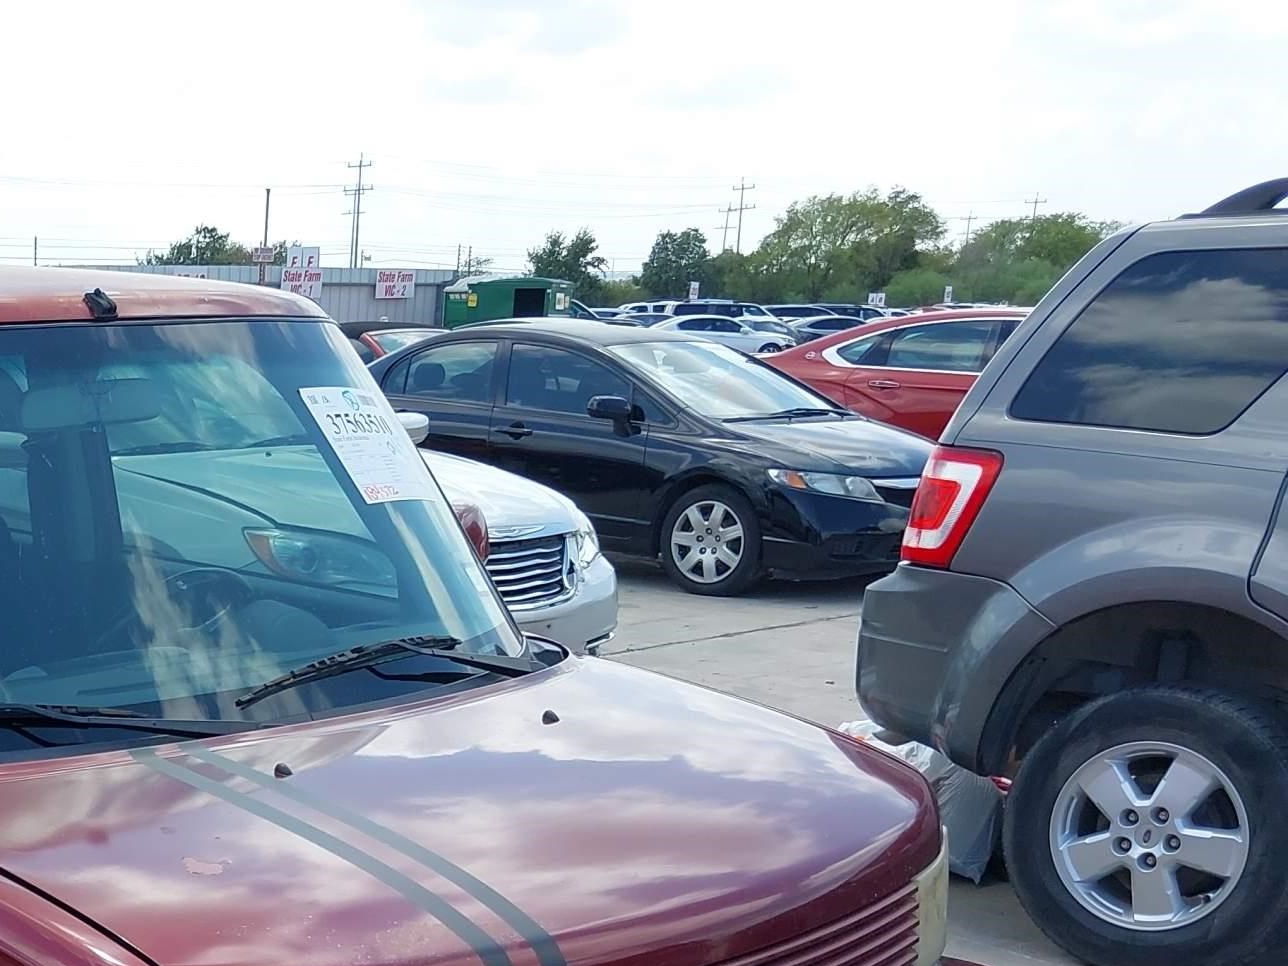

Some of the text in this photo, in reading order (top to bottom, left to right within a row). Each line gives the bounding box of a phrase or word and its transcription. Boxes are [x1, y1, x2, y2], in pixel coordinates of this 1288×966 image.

[283, 270, 321, 282] State Farm
[378, 271, 413, 283] State Farm
[384, 284, 395, 297] VIC
[400, 284, 408, 296] 2
[326, 413, 392, 436] 37563510
